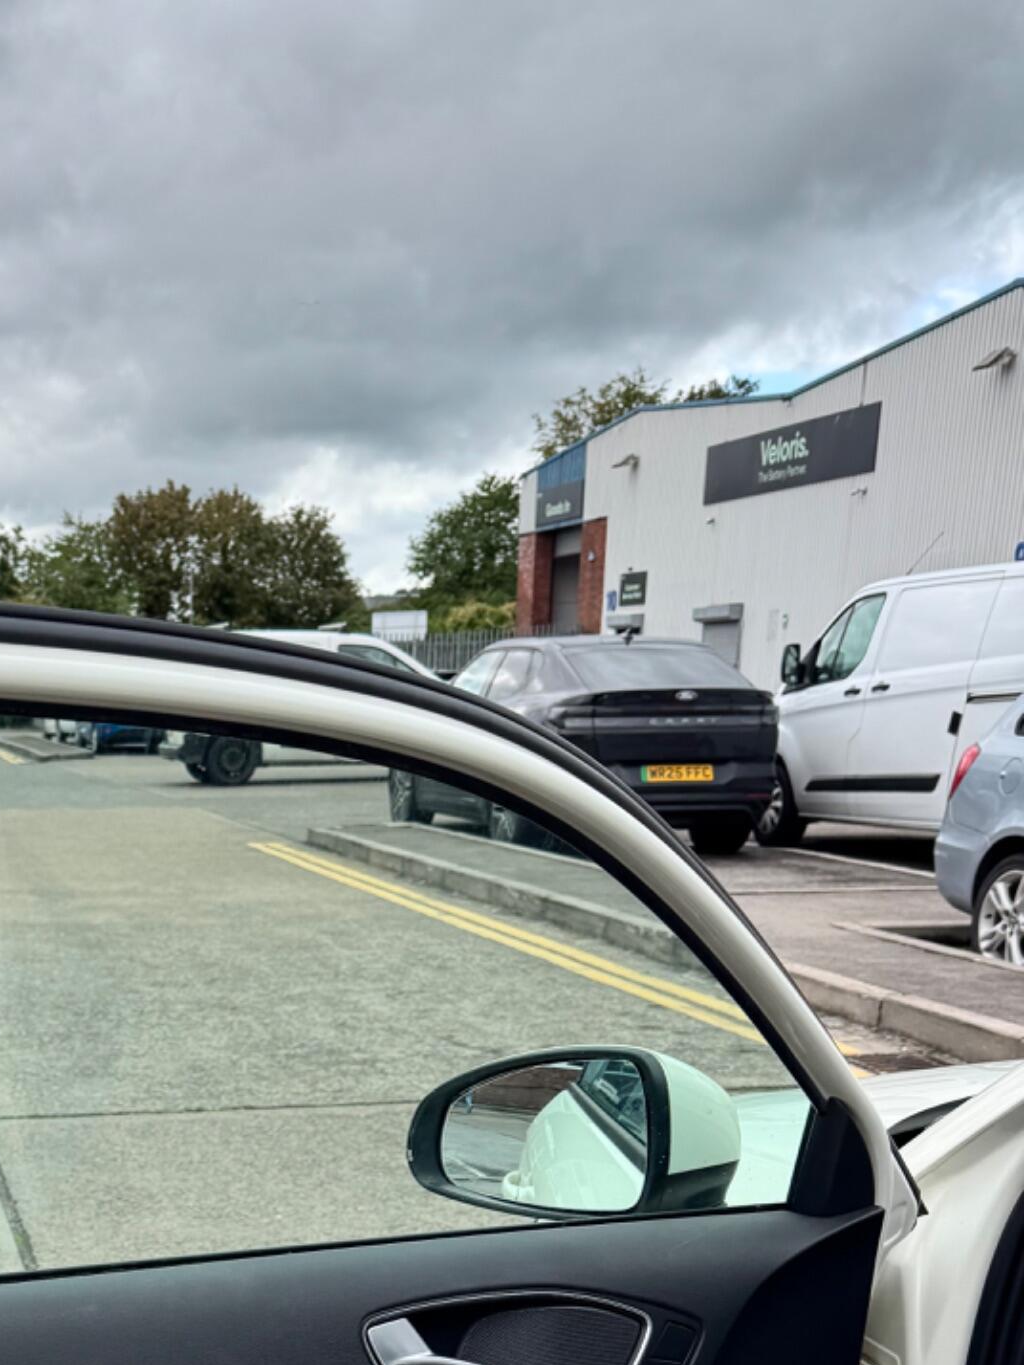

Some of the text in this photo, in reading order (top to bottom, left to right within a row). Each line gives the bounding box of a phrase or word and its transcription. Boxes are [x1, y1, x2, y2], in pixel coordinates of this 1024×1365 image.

[760, 431, 809, 466] Veloris.
[649, 765, 711, 779] WR25 FFC
